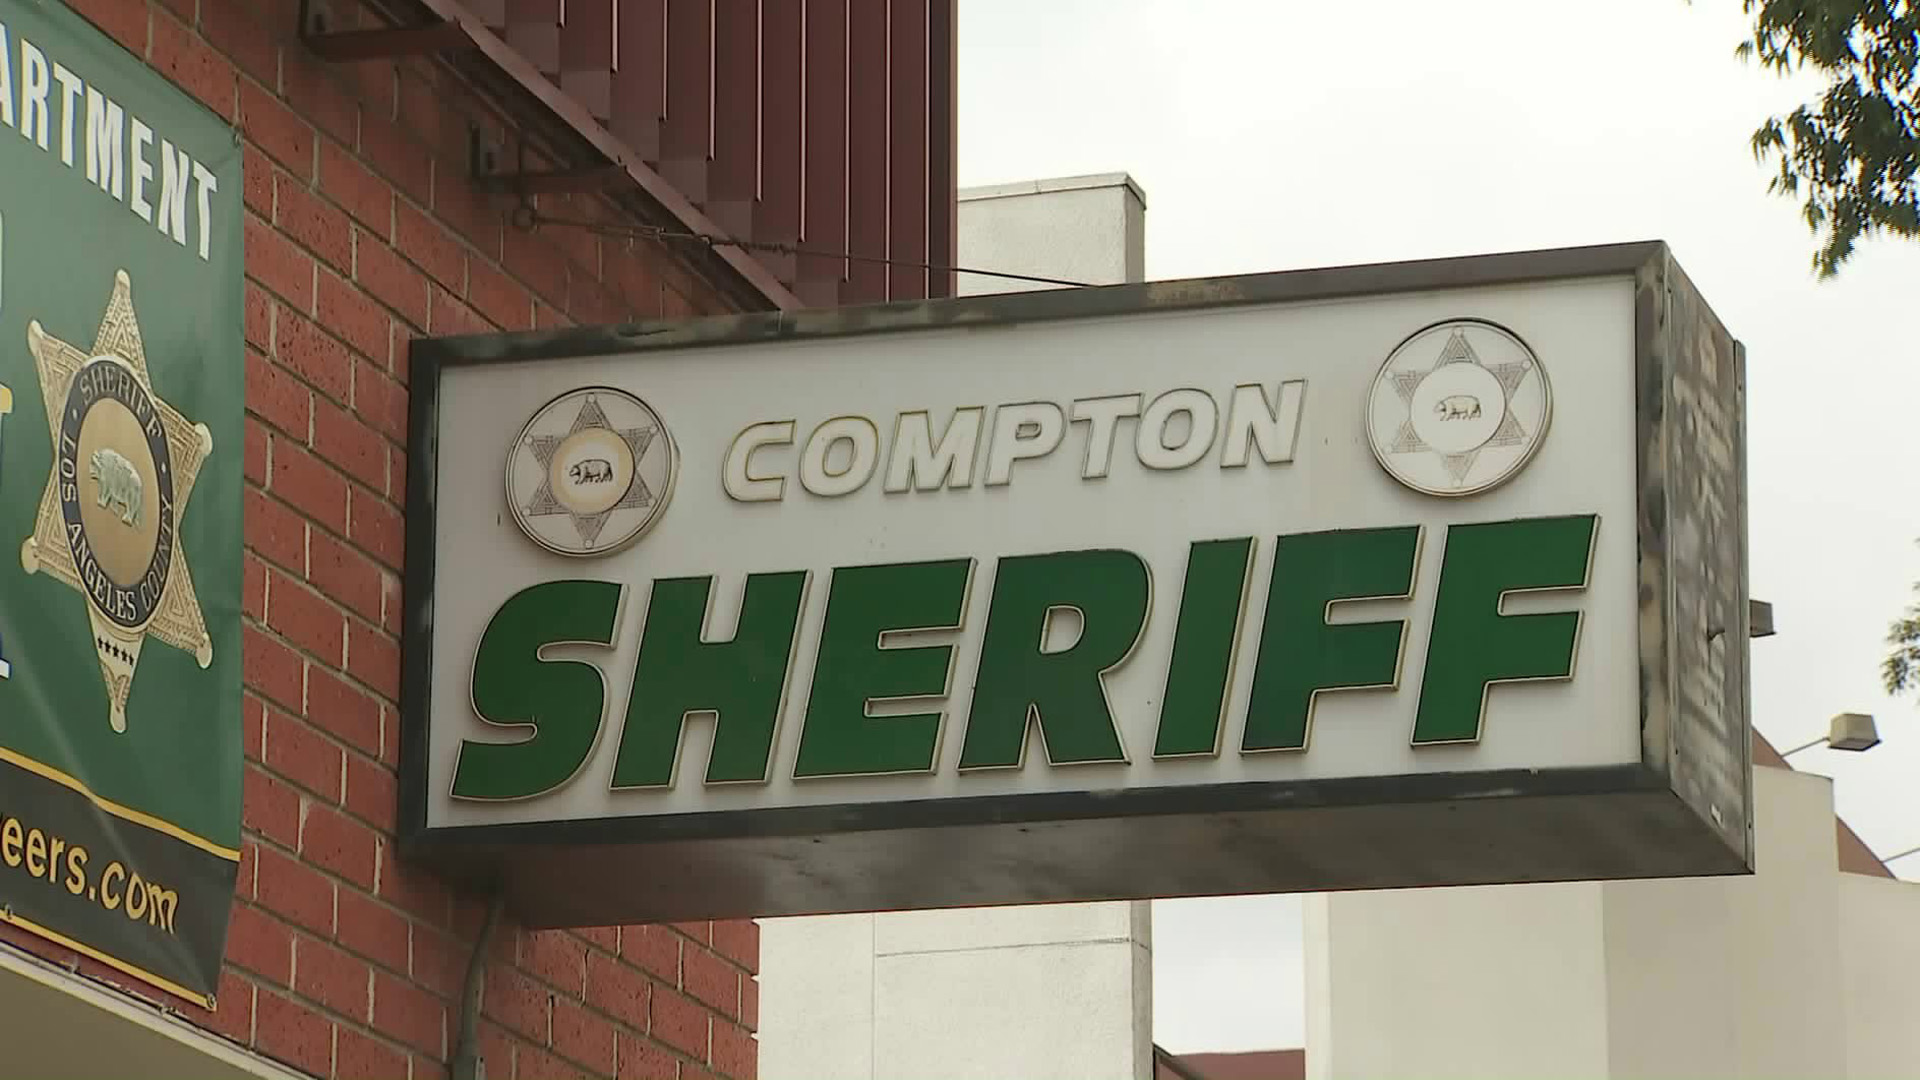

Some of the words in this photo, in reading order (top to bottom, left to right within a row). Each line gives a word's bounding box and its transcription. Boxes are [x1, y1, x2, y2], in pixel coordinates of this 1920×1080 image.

[80, 364, 163, 439] SHERIFF
[721, 379, 1308, 502] COMPTON
[60, 431, 77, 503] LOS
[68, 522, 137, 622] ANGELES
[140, 493, 173, 610] COUNTY
[451, 513, 1601, 803] SHERIFF
[1, 817, 179, 936] eers.com
